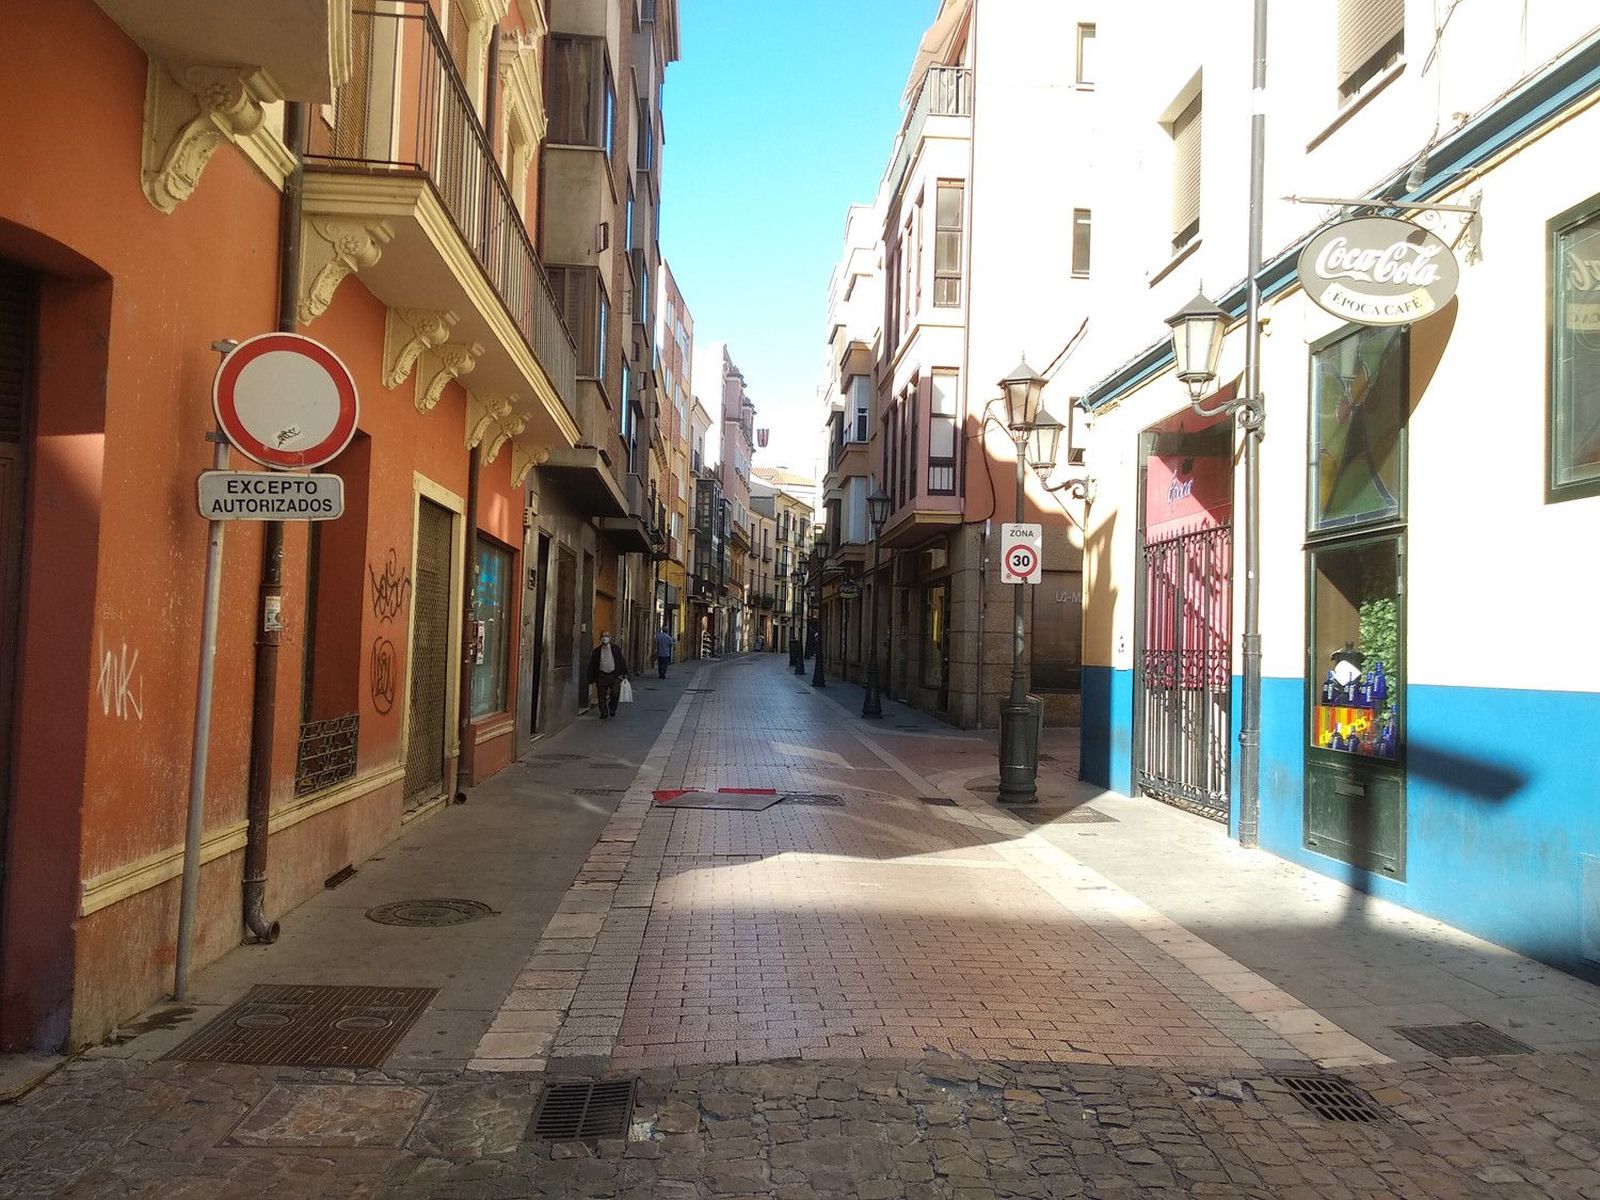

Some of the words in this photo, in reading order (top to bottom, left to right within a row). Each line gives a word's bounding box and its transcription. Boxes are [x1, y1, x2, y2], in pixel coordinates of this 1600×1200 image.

[1384, 295, 1423, 316] CAFÉ
[227, 480, 318, 495] EXCEPTO
[211, 498, 333, 513] AUTORIZADOS
[1009, 529, 1034, 538] ZONA
[1012, 555, 1030, 567] 30
